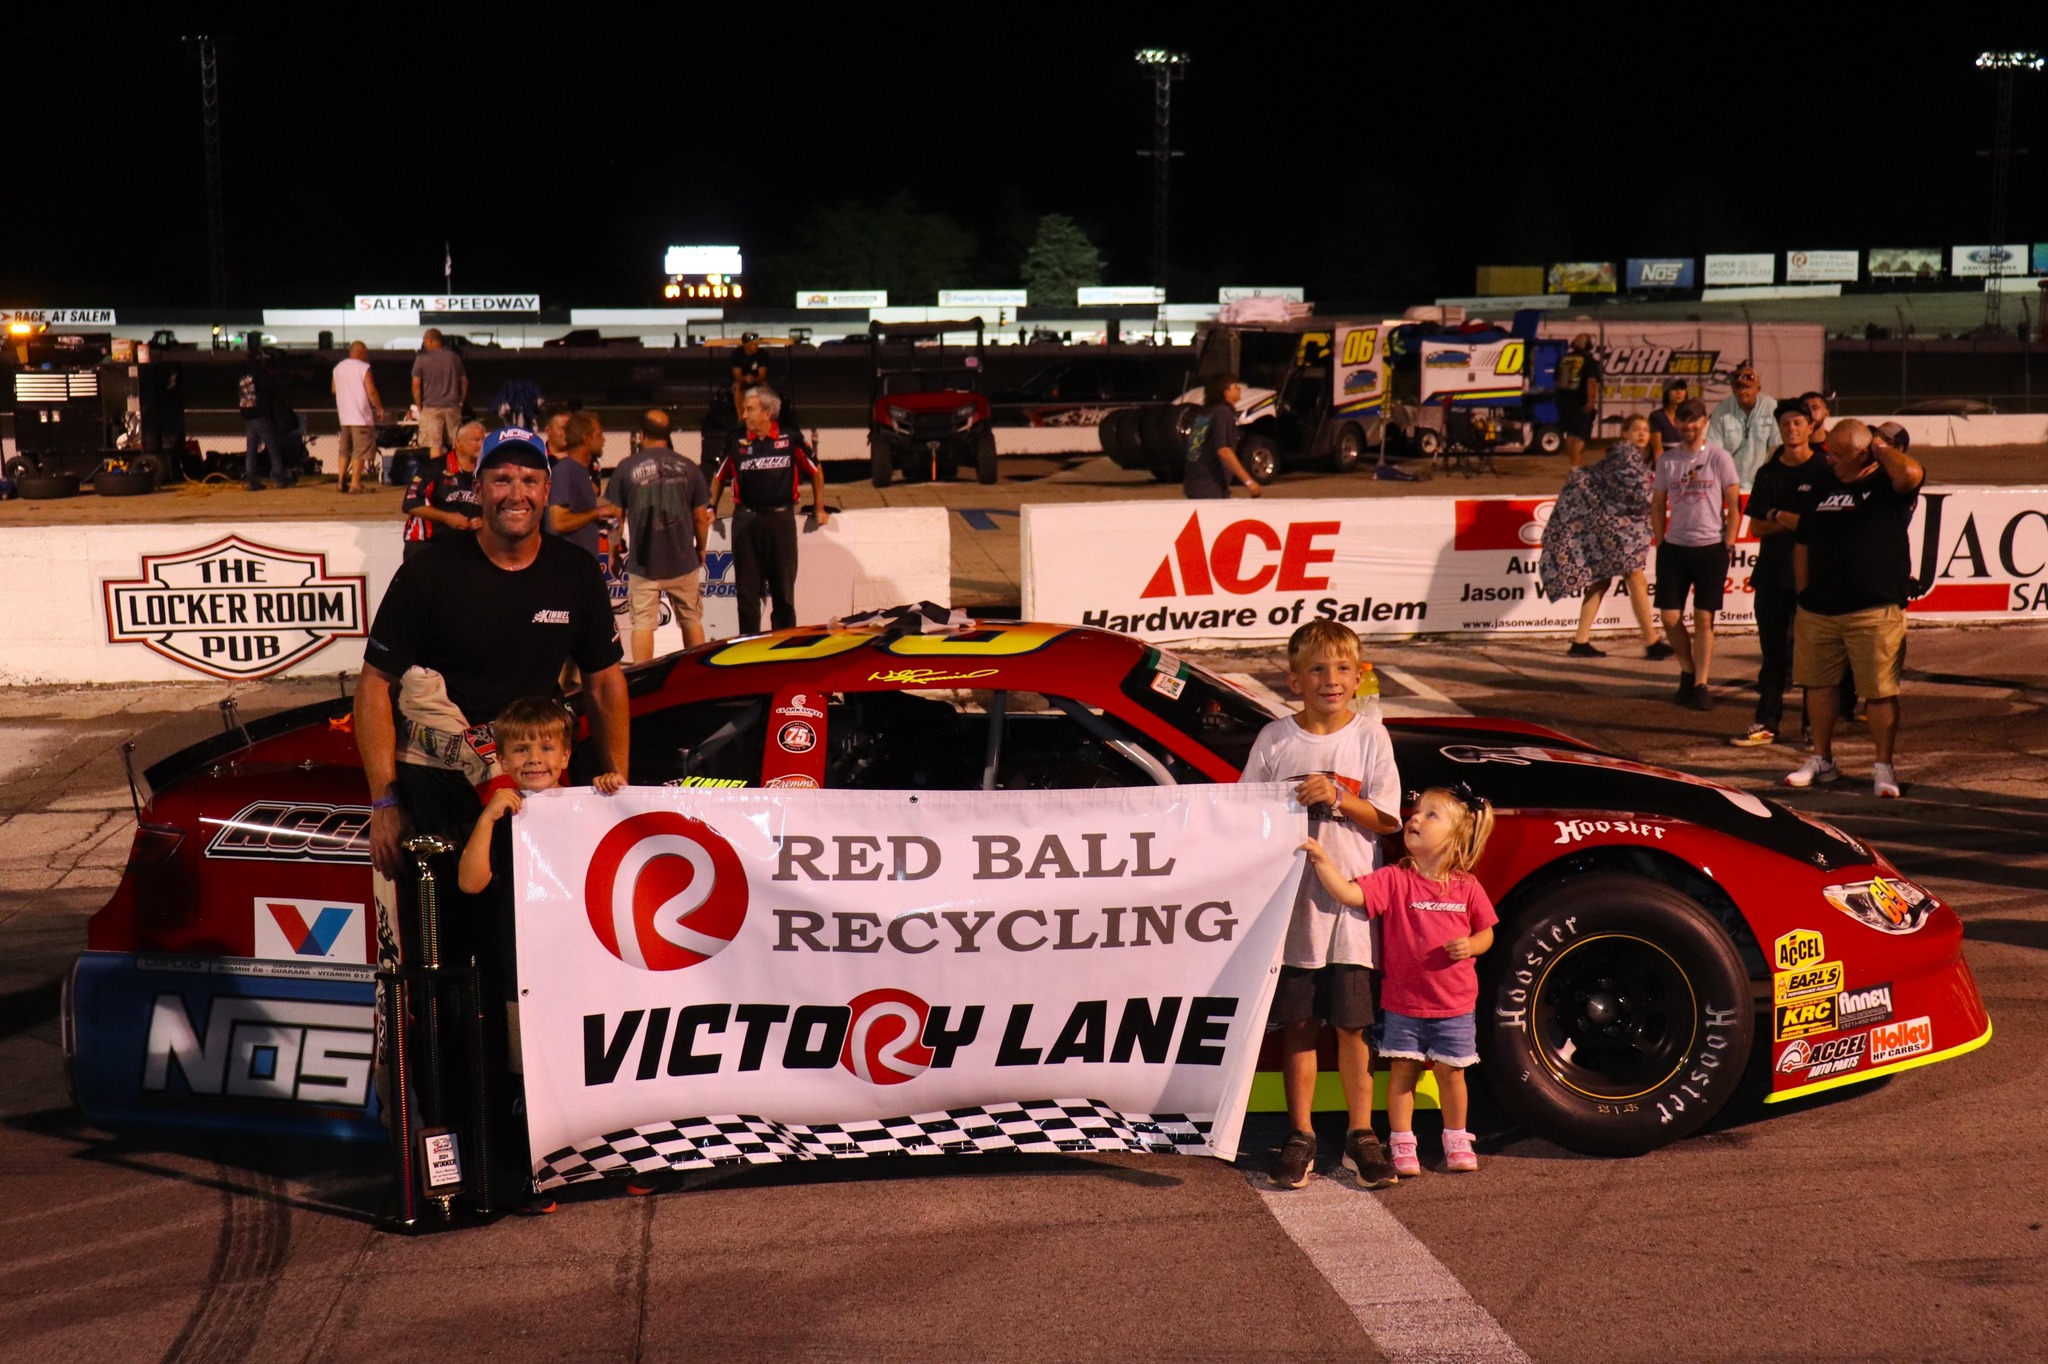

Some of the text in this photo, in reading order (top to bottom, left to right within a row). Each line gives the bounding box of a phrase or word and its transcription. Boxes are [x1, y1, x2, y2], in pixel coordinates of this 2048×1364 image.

[1641, 263, 1683, 281] NOS
[14, 310, 111, 322] RACE AT SALEM
[359, 297, 536, 310] SALEM SPEEDWAY
[1341, 328, 1378, 367] 06
[1604, 347, 1672, 375] CRA
[1669, 358, 1713, 373] JEGS
[499, 428, 533, 441] NOS
[1139, 509, 1341, 599] ACE
[195, 558, 268, 584] THE
[1460, 583, 1525, 602] Jason
[128, 591, 345, 627] LOCKER ROOM
[1081, 597, 1428, 634] Hardware of Salem
[1719, 611, 1754, 621] Street
[199, 634, 280, 663] PUB
[776, 707, 823, 718] CLARKSVILLE
[786, 727, 809, 744] 75
[1554, 819, 1666, 845] Hoosier
[771, 832, 1176, 882] RED BALL
[772, 900, 1239, 954] RECYCLING
[1780, 937, 1821, 967] ACCEL
[217, 965, 250, 973] VITAMIN
[271, 968, 311, 976] GUARANA
[318, 970, 351, 978] VITAMIN
[1497, 915, 1578, 1033] Hoosier
[1789, 967, 1838, 990] EARL'S
[1782, 1001, 1832, 1027] KRC
[1839, 987, 1893, 1016] finney
[142, 991, 377, 1106] NOS
[583, 988, 1239, 1086] VICTORY LANE
[1808, 1032, 1868, 1064] ACCEL
[1872, 1021, 1930, 1053] Holley
[1656, 1006, 1737, 1125] Hoosier
[1873, 1043, 1921, 1061] HP CARBS
[1809, 1056, 1860, 1078] AUTO PARTS
